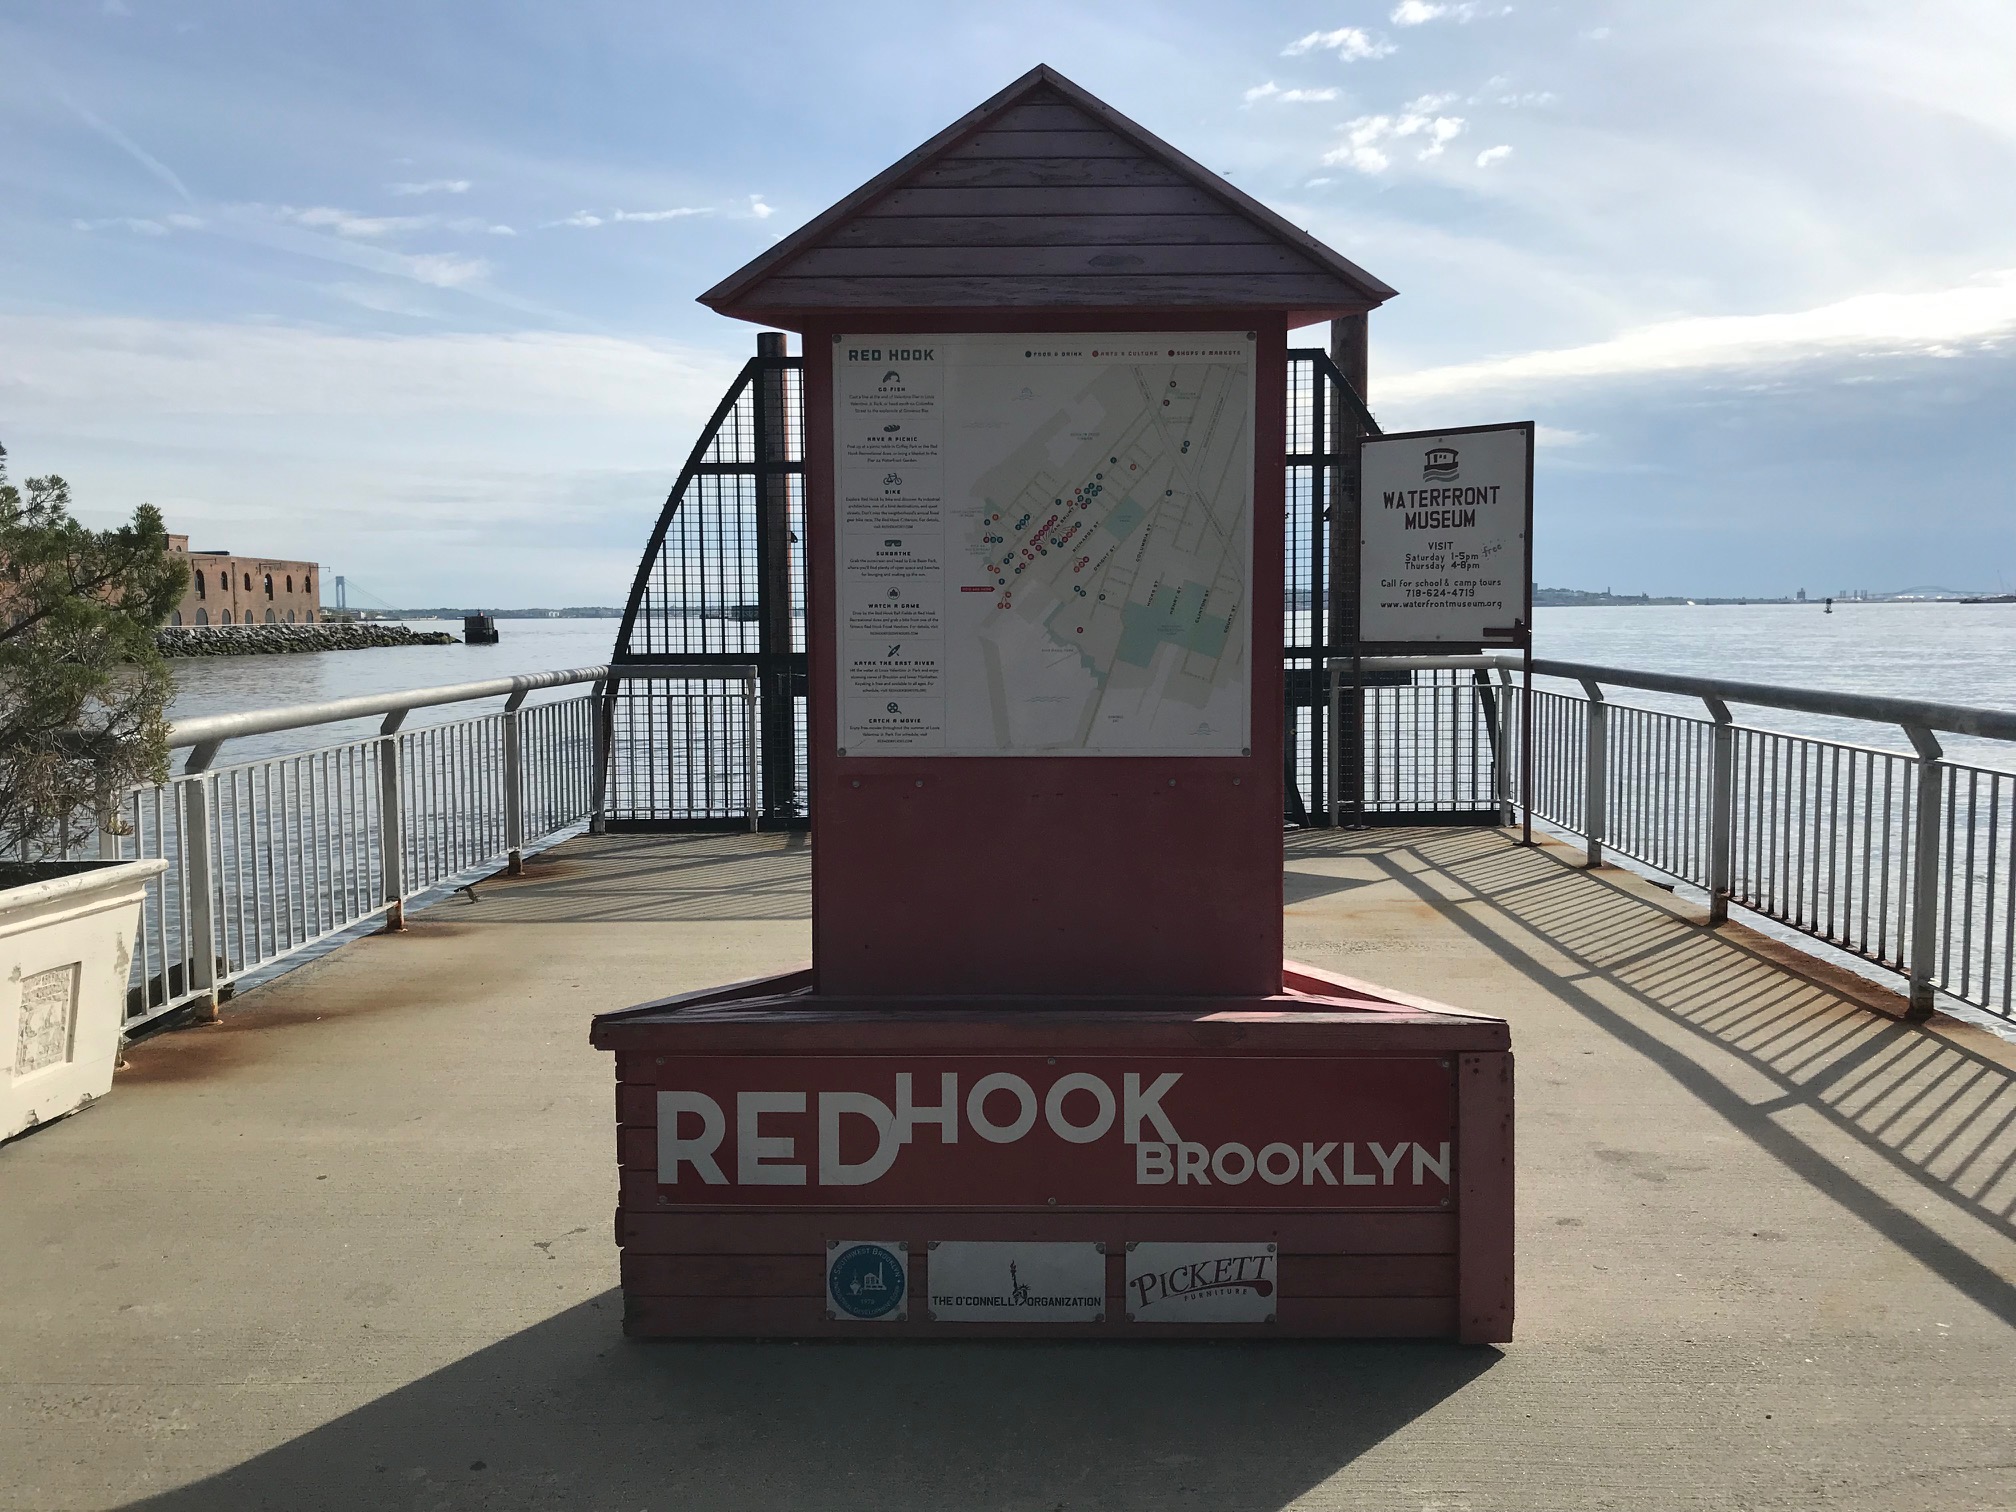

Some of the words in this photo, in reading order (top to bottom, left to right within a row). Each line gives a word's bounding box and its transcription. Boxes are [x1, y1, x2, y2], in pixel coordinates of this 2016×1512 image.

[848, 349, 881, 361] RED
[889, 349, 935, 361] HOOK
[1383, 486, 1500, 509] WATERFRONT
[1405, 509, 1475, 530] MUSEUM
[1072, 529, 1094, 552] RICHARDS
[1135, 533, 1149, 562] COLUMBIA
[1428, 541, 1454, 551] VISIT
[1093, 553, 1109, 571] DWIGHT
[1405, 553, 1445, 563] Saturday
[1451, 552, 1479, 562] 1-5pm
[1405, 562, 1445, 572] Thursday
[1451, 561, 1480, 571] 4-8pm
[1381, 579, 1396, 587] Call
[1399, 579, 1412, 587] for
[1415, 578, 1442, 587] school
[1444, 578, 1449, 587] &
[1454, 580, 1477, 589] camp
[1479, 579, 1502, 587] tours
[1405, 589, 1475, 597] 718-624-4719
[1194, 598, 1207, 623] CLINTON
[1380, 600, 1503, 610] www.waterfrontmuseum.org
[1223, 614, 1233, 633] COURT
[657, 1091, 902, 1187] RED
[896, 1072, 1184, 1145] HOOK
[1136, 1142, 1450, 1186] BROOKLYN
[834, 1248, 870, 1274] SOUTHWEST
[872, 1248, 901, 1278] BROOKLYN
[1129, 1256, 1274, 1309] PICKETT
[932, 1296, 954, 1306] THE
[956, 1296, 1015, 1306] O'CONNELL
[1027, 1297, 1102, 1307] ORGANIZATION
[1184, 1289, 1248, 1302] FURNITURE
